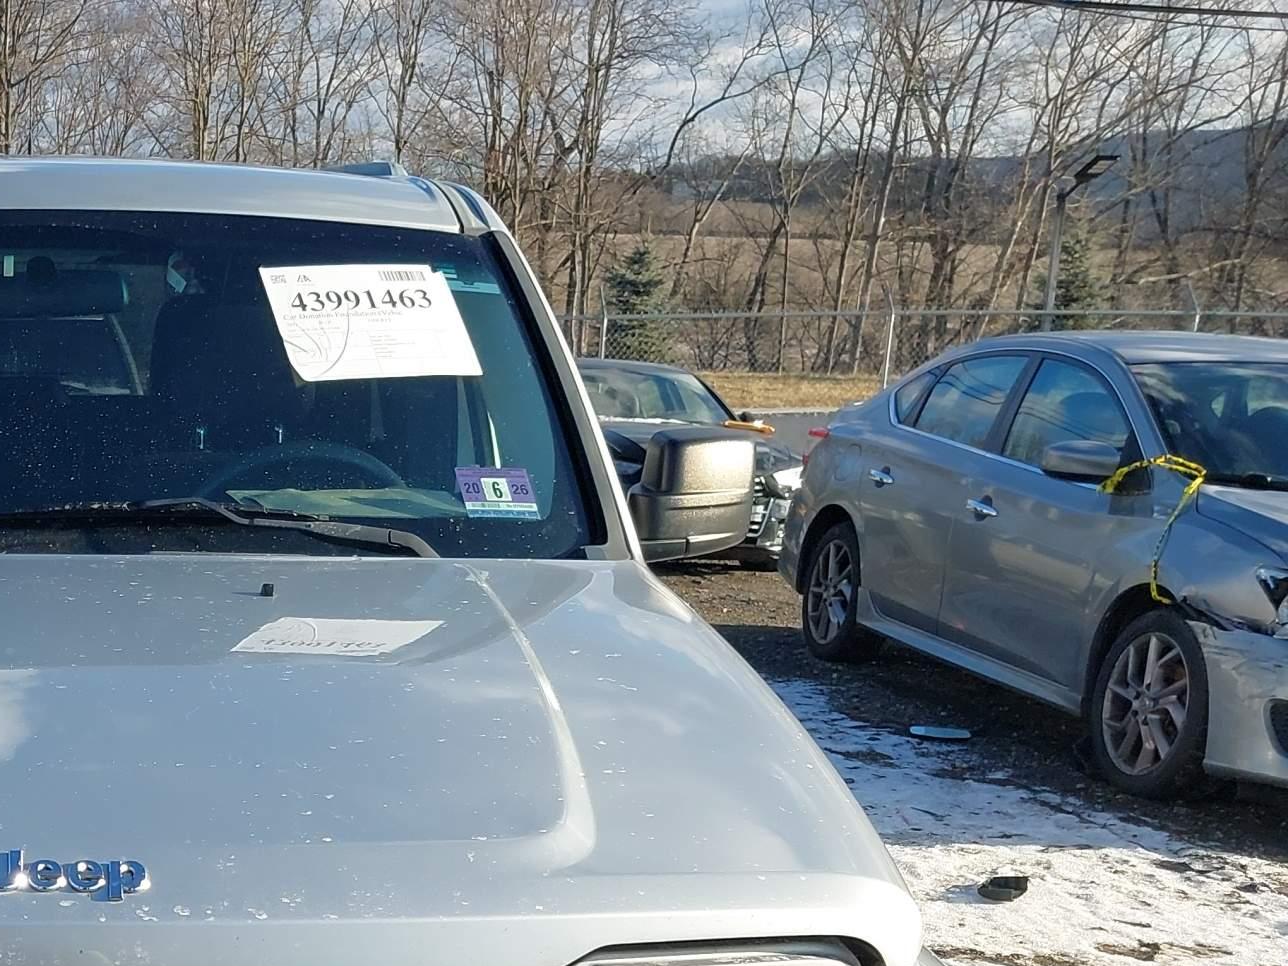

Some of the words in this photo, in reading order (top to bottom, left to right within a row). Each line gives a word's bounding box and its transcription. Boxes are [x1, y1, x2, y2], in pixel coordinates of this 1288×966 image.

[291, 289, 432, 312] 43991463
[463, 482, 481, 495] 20
[492, 481, 504, 499] 6
[511, 484, 529, 496] 26
